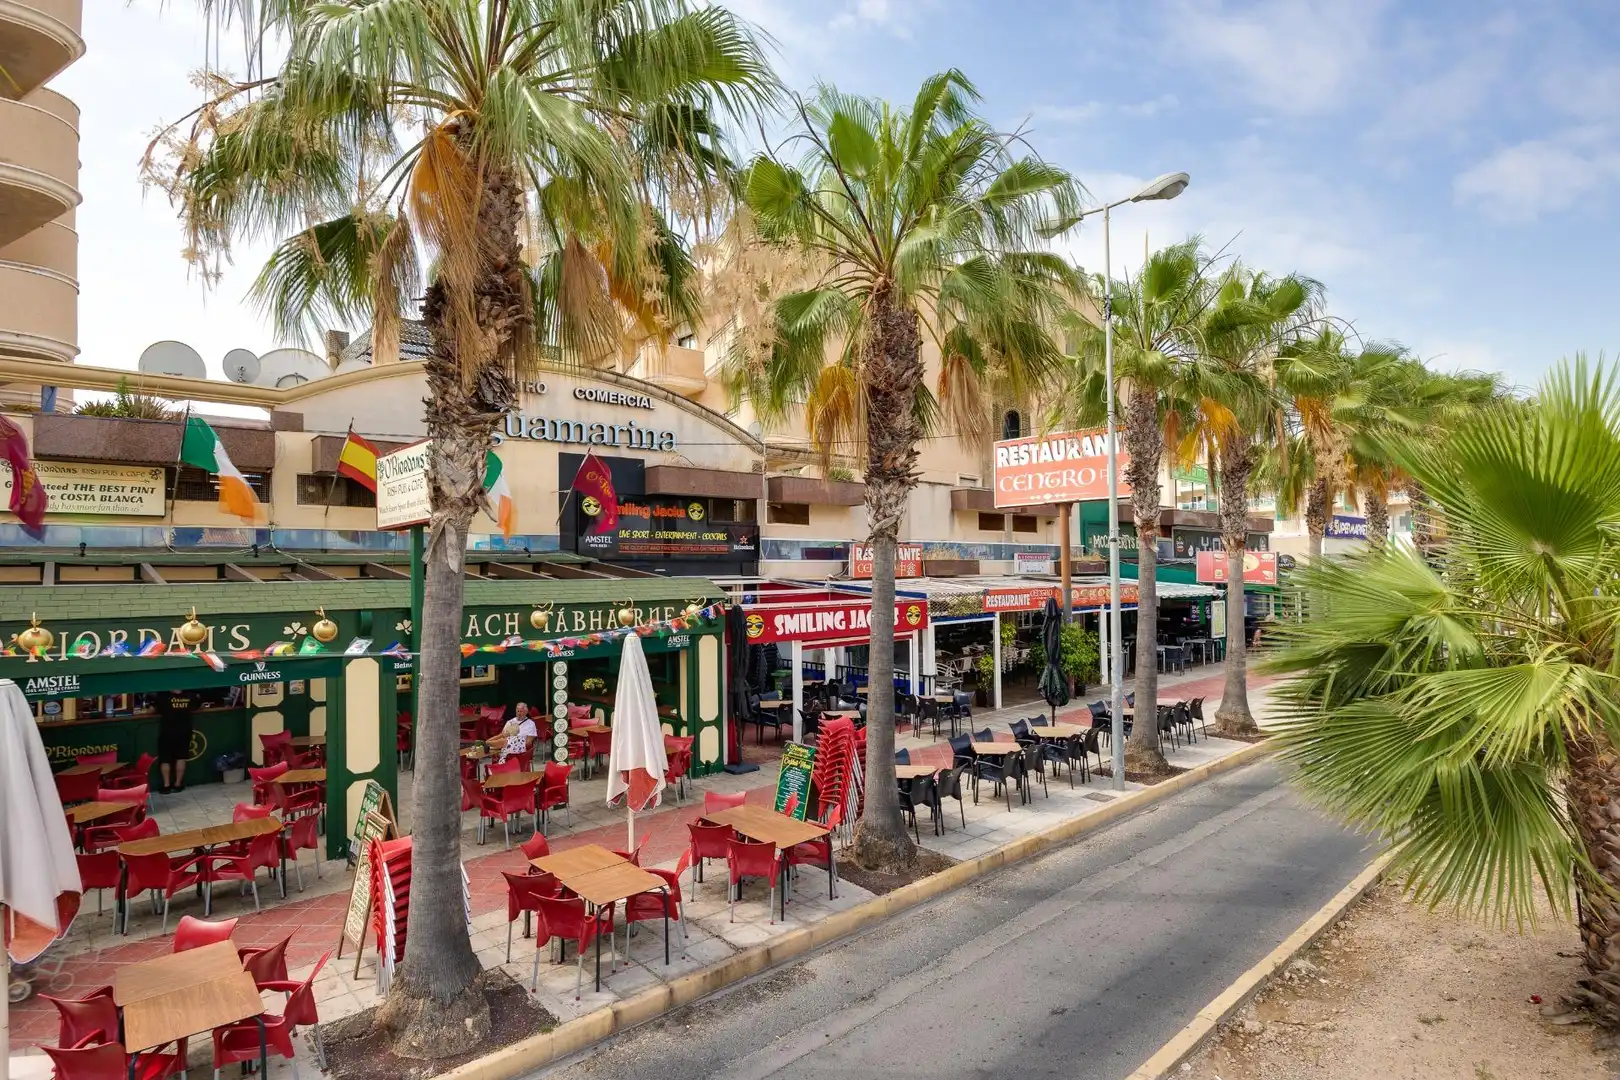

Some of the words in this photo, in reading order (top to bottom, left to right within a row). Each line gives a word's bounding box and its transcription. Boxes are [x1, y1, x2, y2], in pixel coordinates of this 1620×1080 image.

[575, 387, 656, 410] COMERCIAL
[491, 411, 677, 451] uamarina
[1000, 468, 1096, 492] CENTRO
[73, 483, 96, 492] THE
[99, 484, 127, 493] BEST
[130, 486, 157, 494] PINT
[60, 493, 96, 502] COSTA
[100, 494, 144, 504] BLANCA
[585, 535, 612, 544] AMSTEL
[619, 529, 631, 539] LIVE
[632, 530, 650, 539] SPORT
[655, 531, 698, 540] ENTERTAINMENT
[702, 532, 728, 541] COCKTAILS
[986, 594, 1031, 608] RESTAURANTE
[460, 613, 521, 639] ACH
[774, 610, 845, 636] SMILING
[668, 635, 691, 643] AMSTEL
[26, 675, 80, 689] AMSTEL
[239, 671, 281, 682] GUINNESS
